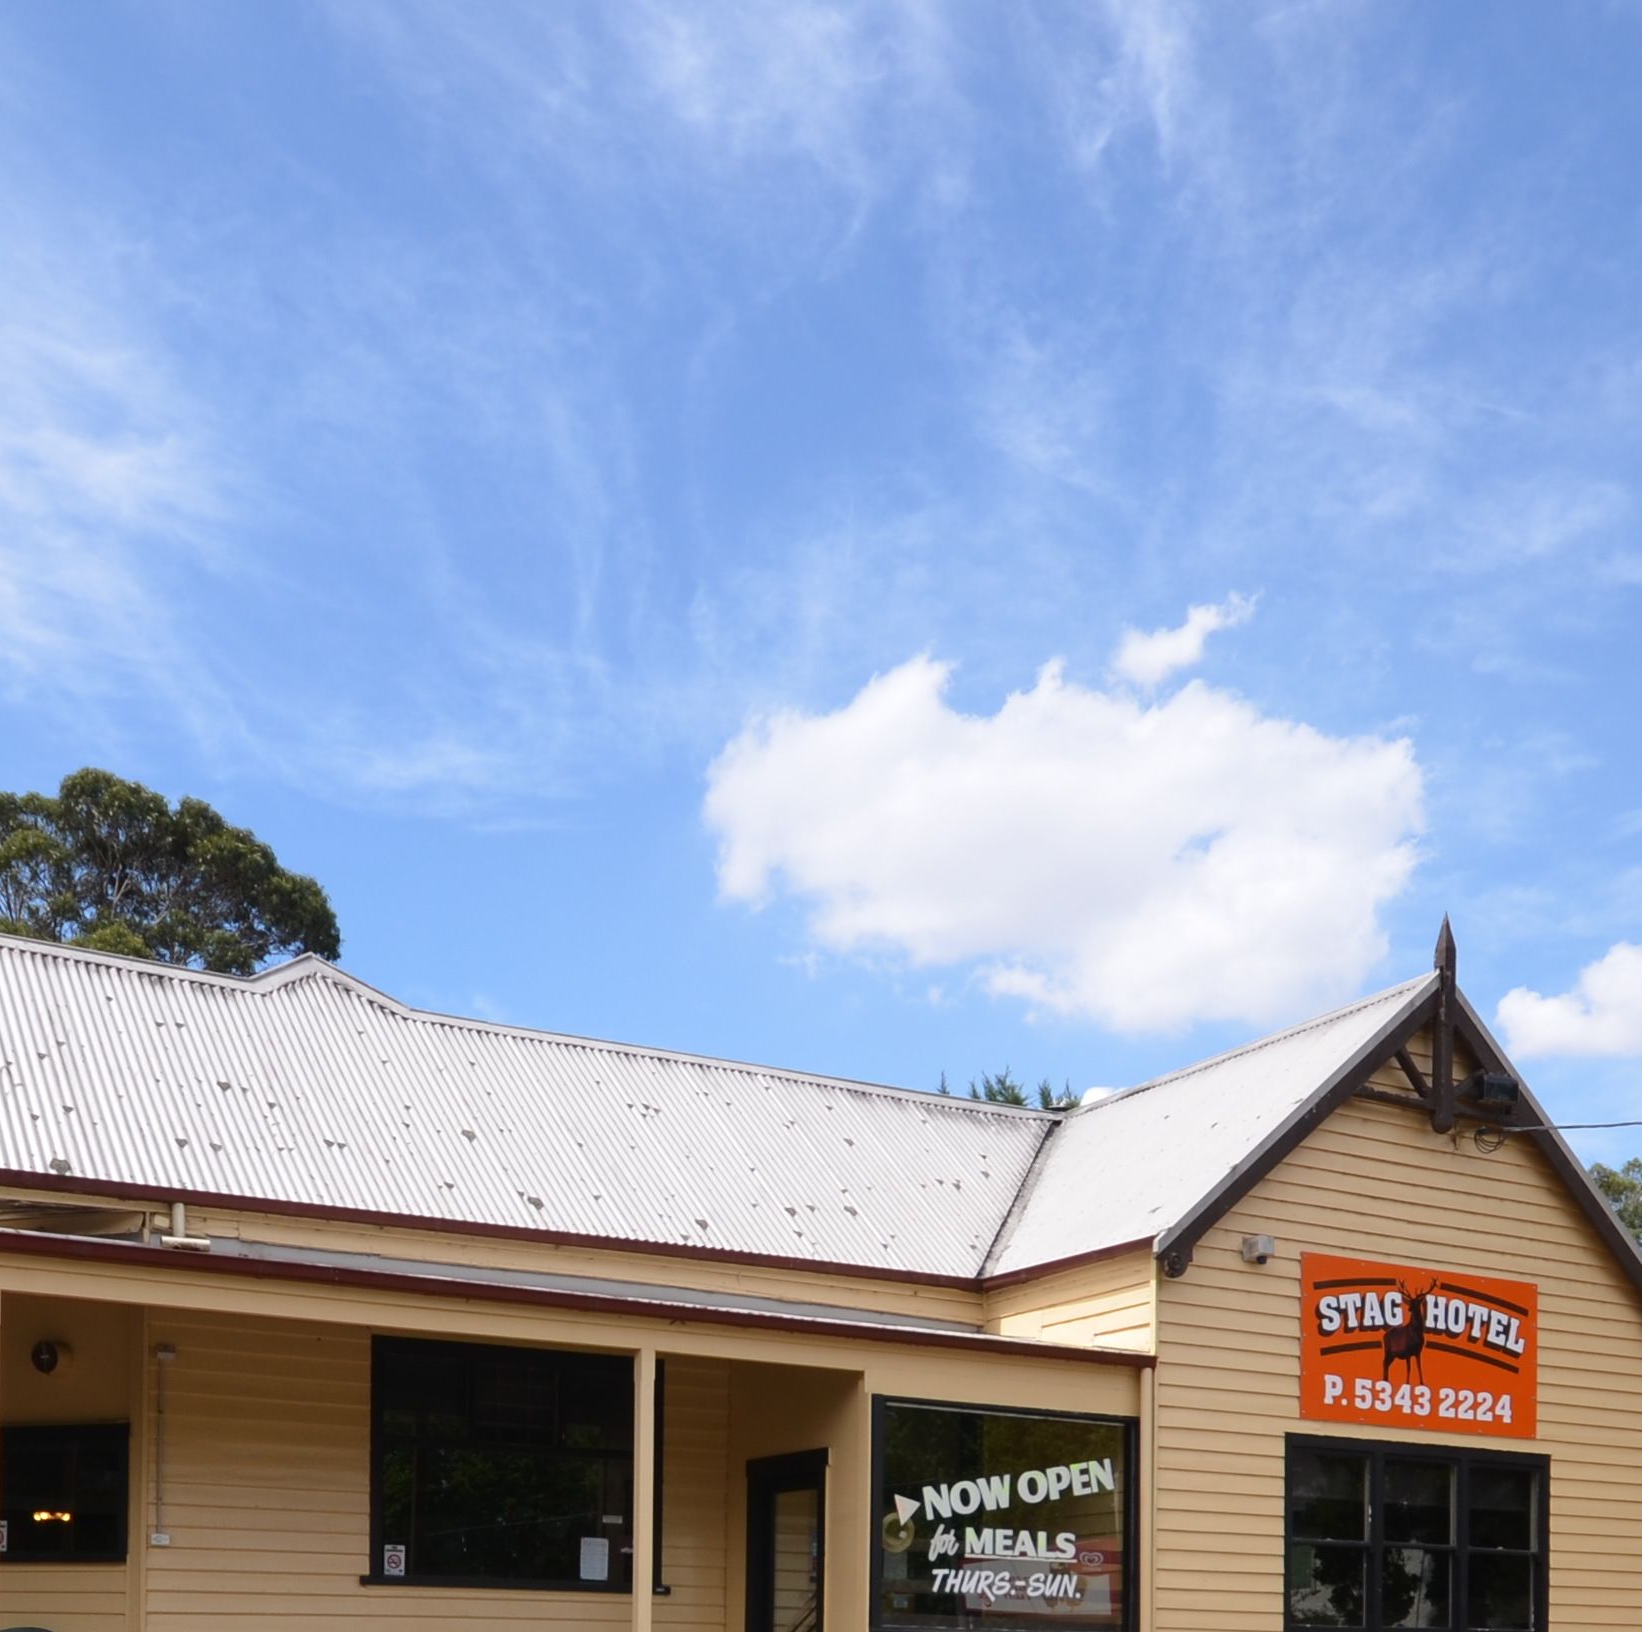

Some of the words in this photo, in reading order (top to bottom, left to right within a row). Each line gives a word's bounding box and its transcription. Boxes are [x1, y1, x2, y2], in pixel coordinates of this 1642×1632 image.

[1316, 1291, 1403, 1334] STAG
[1424, 1294, 1526, 1355] HOTEL
[1323, 1374, 1348, 1406] P.
[1354, 1378, 1431, 1416] 5343
[1438, 1388, 1513, 1424] 2224
[922, 1474, 1011, 1521] NOW
[1017, 1458, 1115, 1503] OPEN
[928, 1523, 960, 1562] for
[965, 1526, 1077, 1559] MEALS
